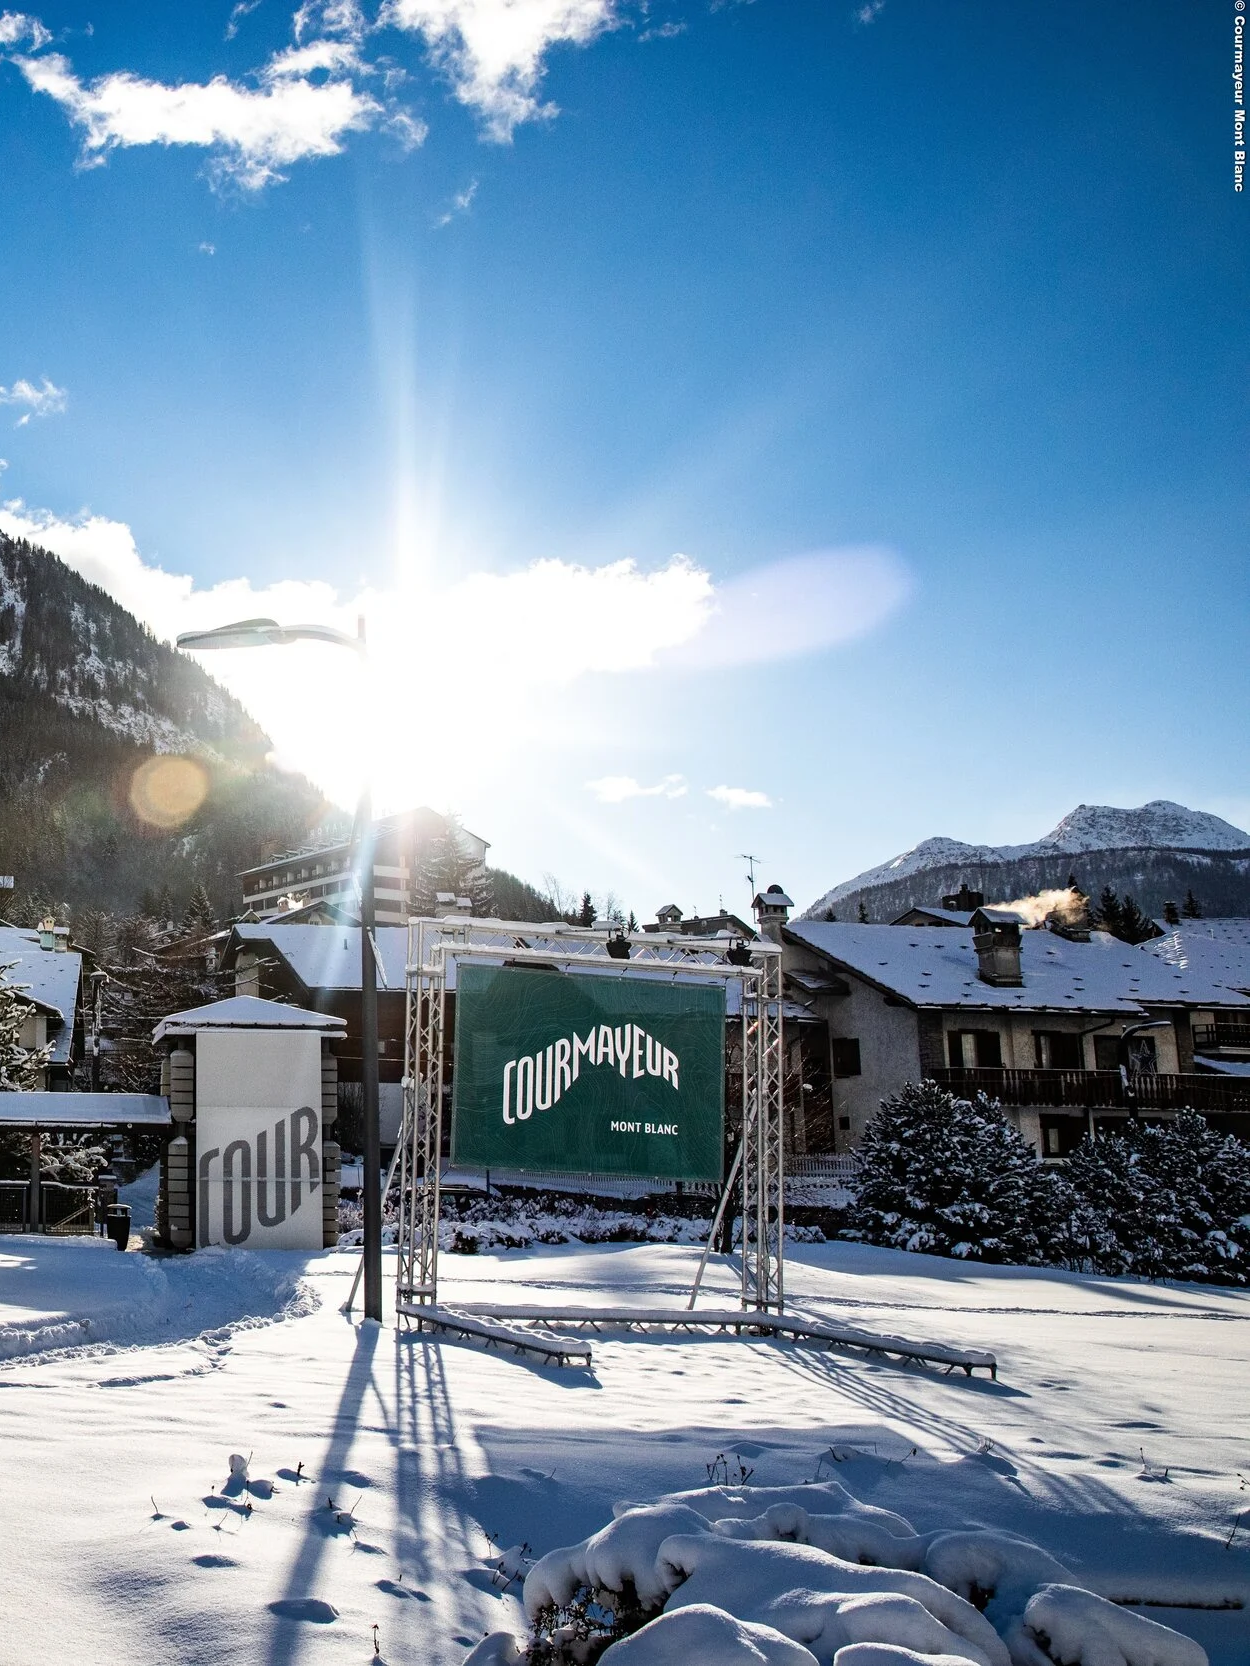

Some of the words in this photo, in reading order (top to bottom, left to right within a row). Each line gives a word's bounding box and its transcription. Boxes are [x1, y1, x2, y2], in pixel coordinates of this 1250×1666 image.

[502, 1023, 680, 1125] COURMAYEUR
[198, 1106, 321, 1249] COUR
[610, 1120, 642, 1133] MONT
[644, 1122, 679, 1136] BLANC
